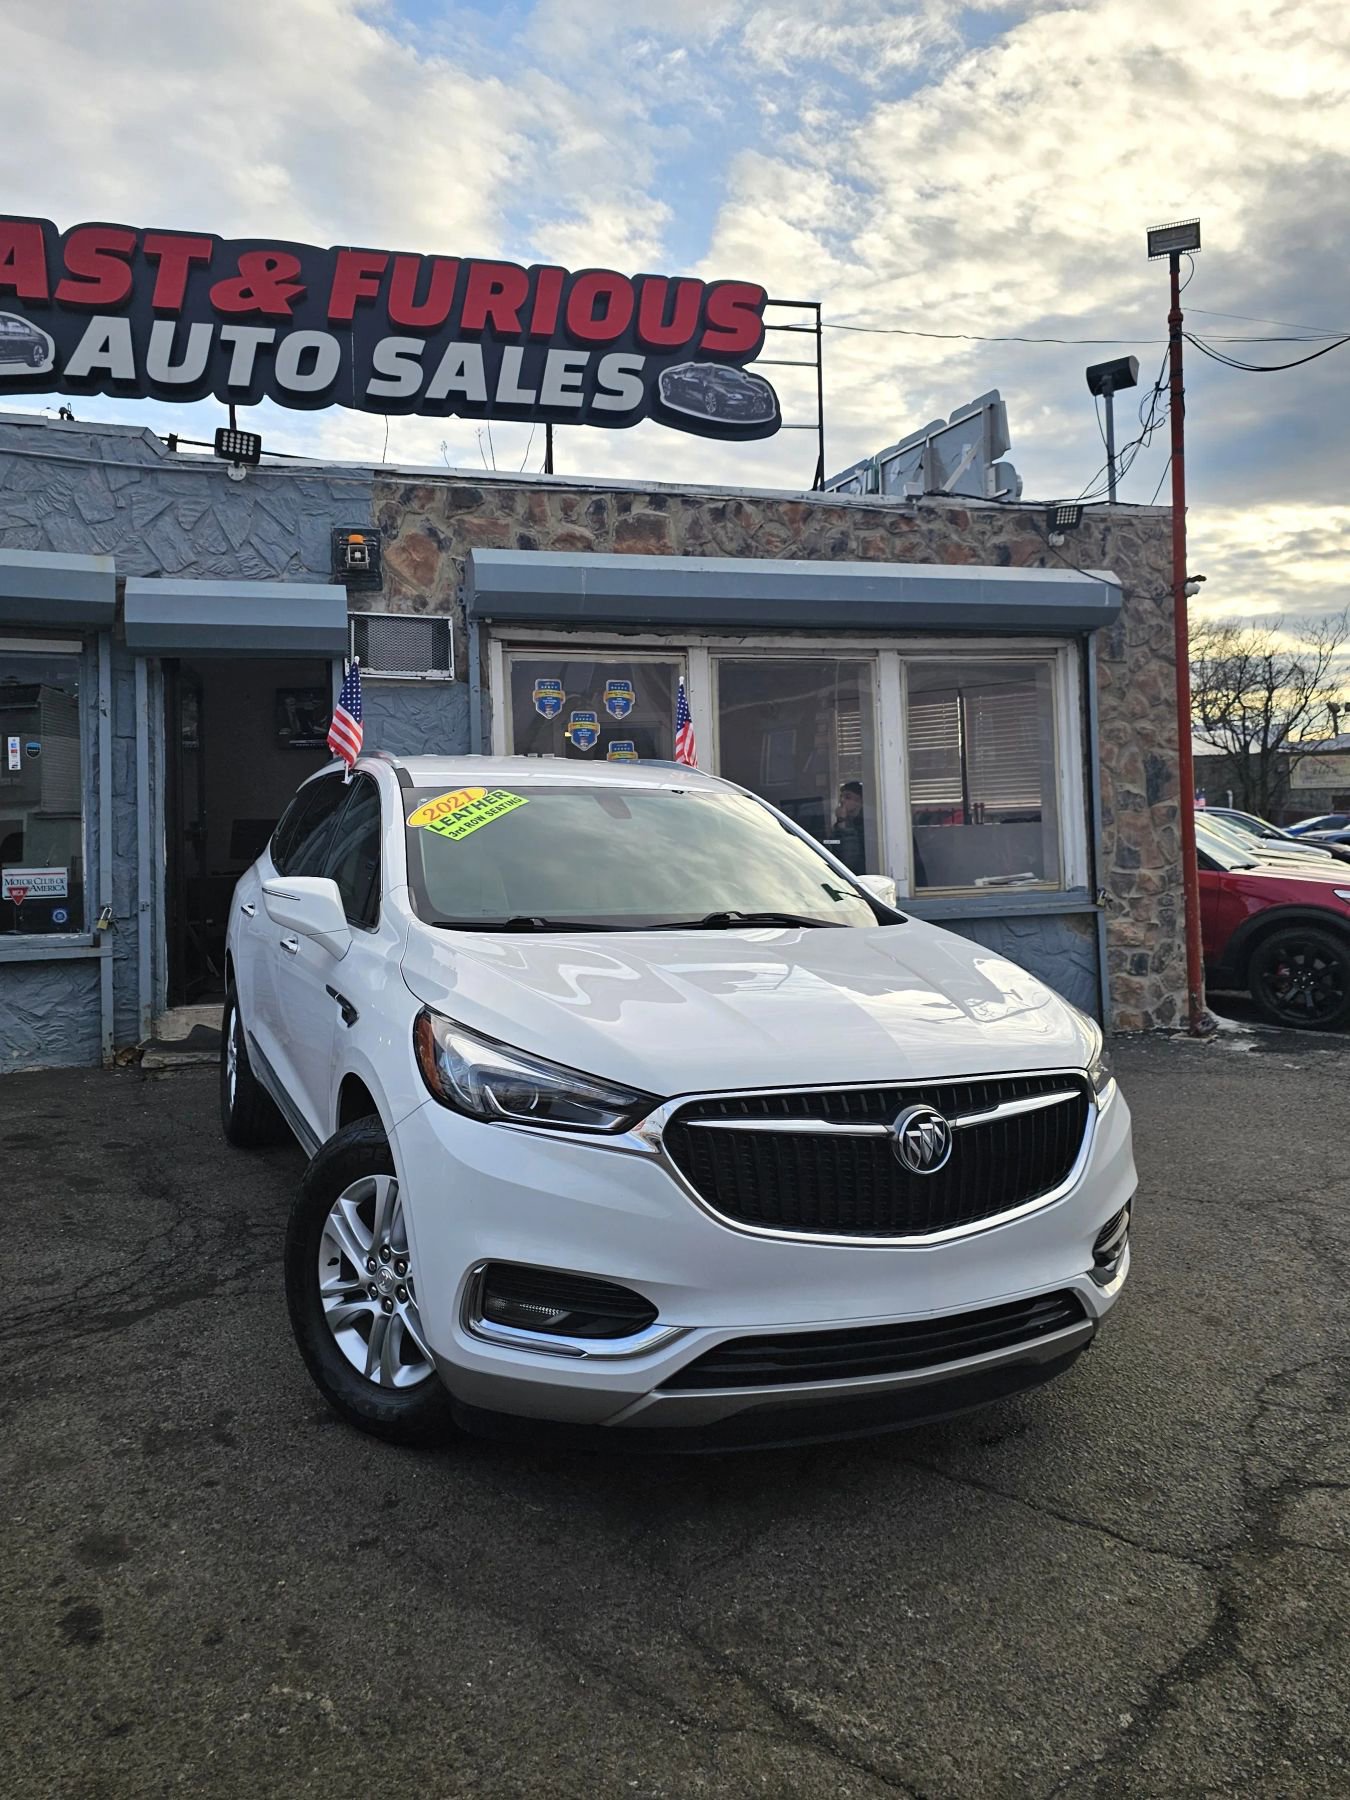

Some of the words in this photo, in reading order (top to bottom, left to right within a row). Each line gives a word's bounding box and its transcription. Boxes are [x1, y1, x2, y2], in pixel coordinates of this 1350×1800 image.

[210, 250, 307, 317] &
[328, 250, 765, 353] FURIOUS
[63, 315, 342, 393] AUTO
[366, 337, 646, 412] SALES
[422, 790, 475, 822] 2021
[429, 790, 510, 833] LEATHER
[448, 826, 466, 838] 3rd
[465, 815, 487, 830] ROW
[484, 797, 522, 817] SEATING
